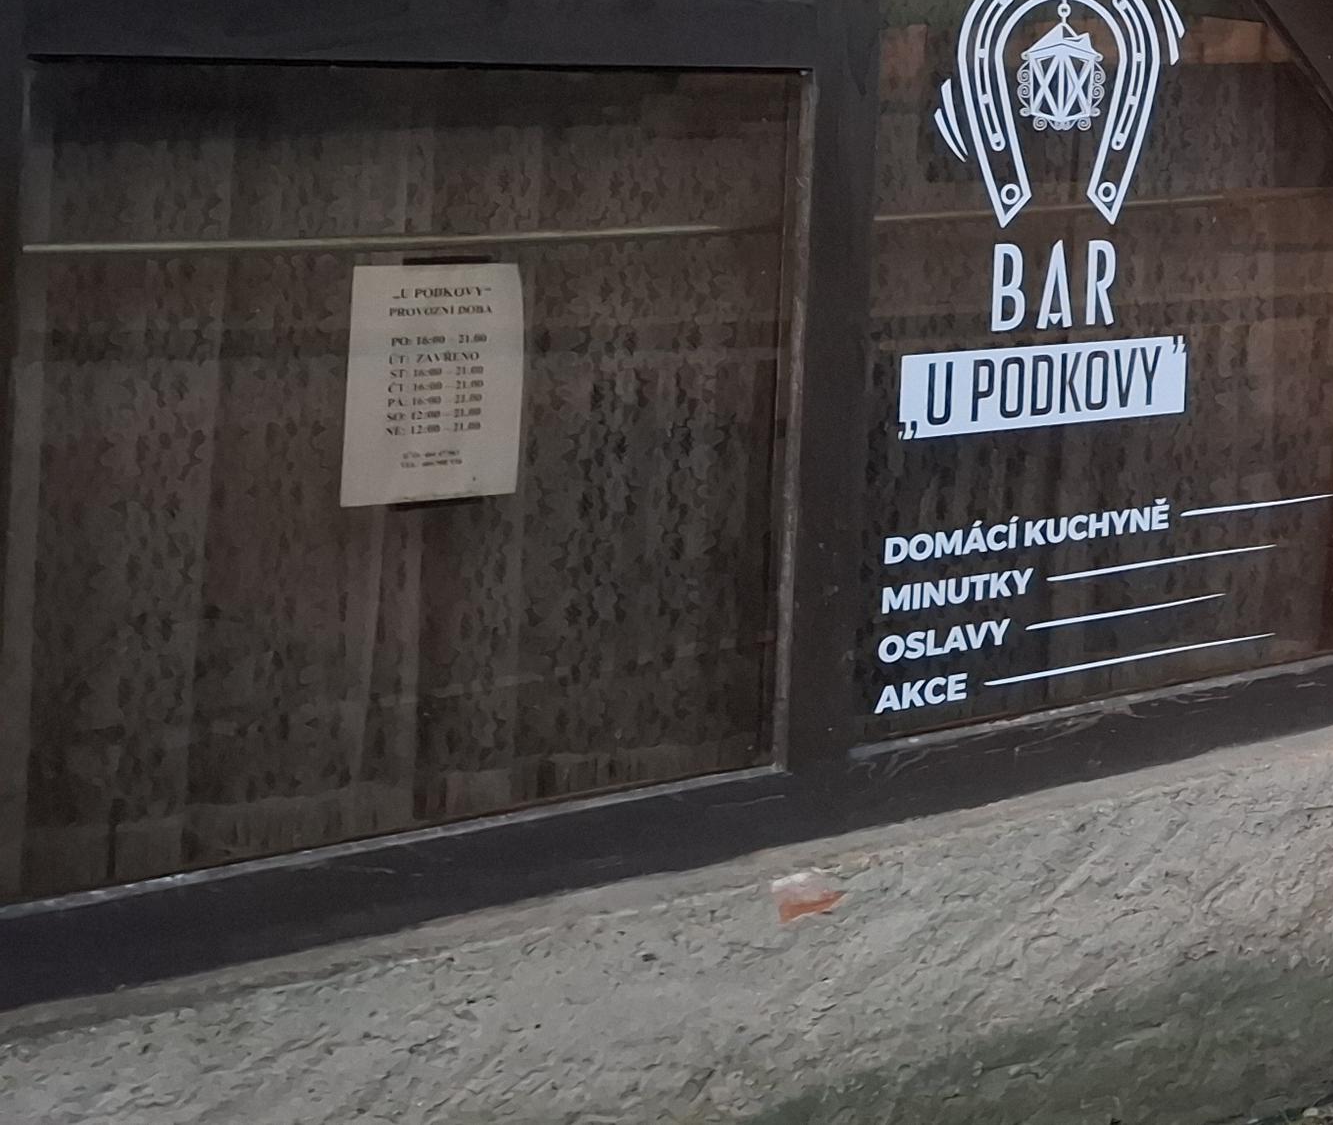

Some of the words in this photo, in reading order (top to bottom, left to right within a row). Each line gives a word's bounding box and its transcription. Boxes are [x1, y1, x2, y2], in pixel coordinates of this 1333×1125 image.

[990, 238, 1116, 333] BAR
[883, 517, 1021, 565] DOMÁCÍ
[1023, 495, 1171, 549] KUCHYNĚ
[880, 566, 1034, 615] MINUTKY
[877, 618, 1012, 666] OSLAVY
[873, 672, 969, 715] AKCE
